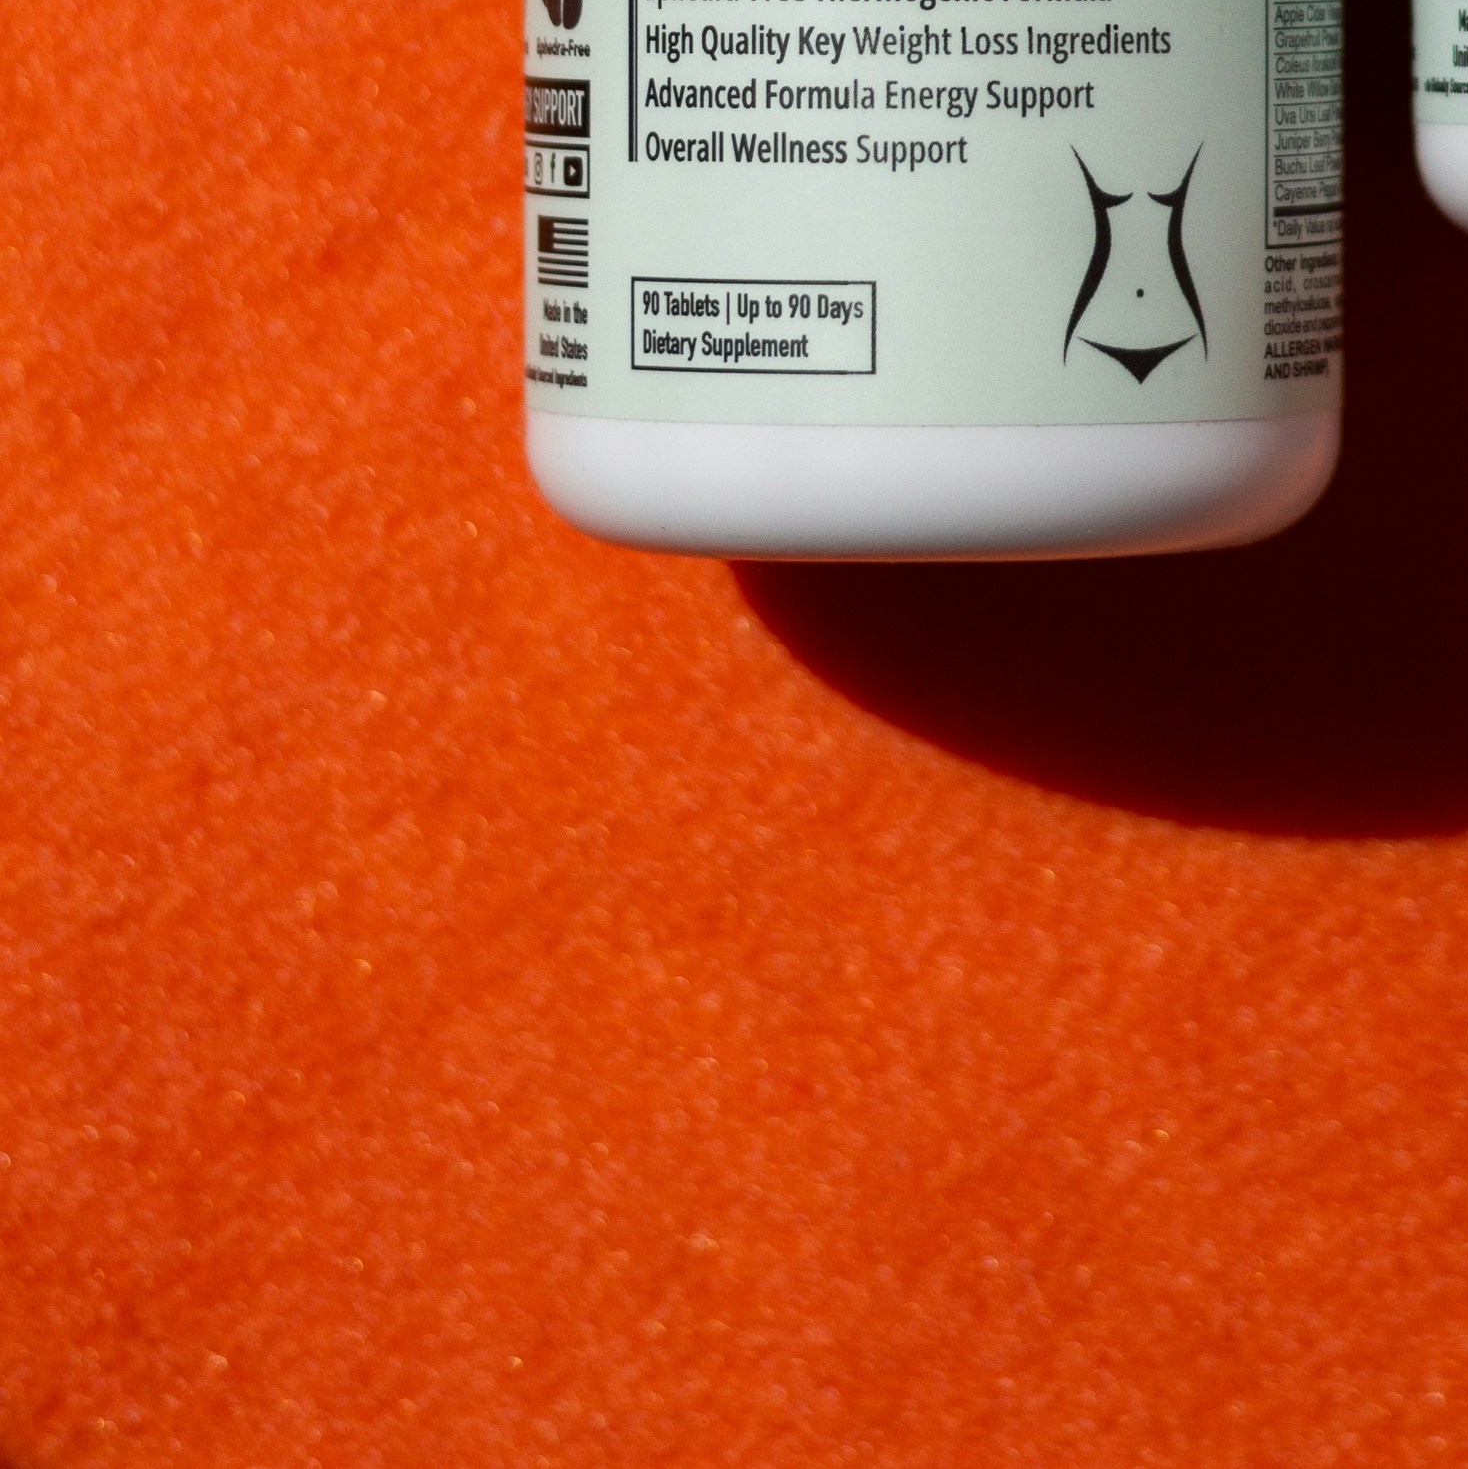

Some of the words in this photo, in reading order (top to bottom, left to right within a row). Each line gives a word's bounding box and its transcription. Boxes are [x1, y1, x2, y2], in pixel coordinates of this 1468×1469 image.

[1274, 6, 1305, 26] Apple
[646, 23, 694, 64] High
[701, 23, 791, 65] Quality
[798, 26, 846, 65] Key
[852, 24, 952, 65] Weight
[960, 26, 1019, 56] Loss
[1027, 23, 1172, 65] Ingredients
[644, 76, 757, 110] Advanced
[765, 78, 875, 110] Formula
[885, 80, 979, 119] Energy
[986, 80, 1095, 118] Support
[1274, 82, 1305, 99] White
[532, 87, 585, 127] SUPPORT
[1274, 107, 1297, 125] Uva
[645, 130, 724, 163] Overall
[730, 131, 848, 164] Wellness
[856, 134, 968, 173] Support
[1274, 158, 1307, 176] Buchu
[1265, 255, 1297, 272] Other
[1264, 276, 1297, 294] acid,
[563, 299, 571, 323] in
[573, 300, 588, 324] the
[642, 290, 660, 316] 90
[663, 291, 721, 318] Tablets
[737, 292, 760, 325] Up
[764, 295, 783, 319] to
[788, 293, 811, 319] 90
[817, 293, 864, 326] Days
[643, 328, 697, 362] Dietary
[701, 330, 809, 364] Supplement
[1264, 362, 1291, 380] AND
